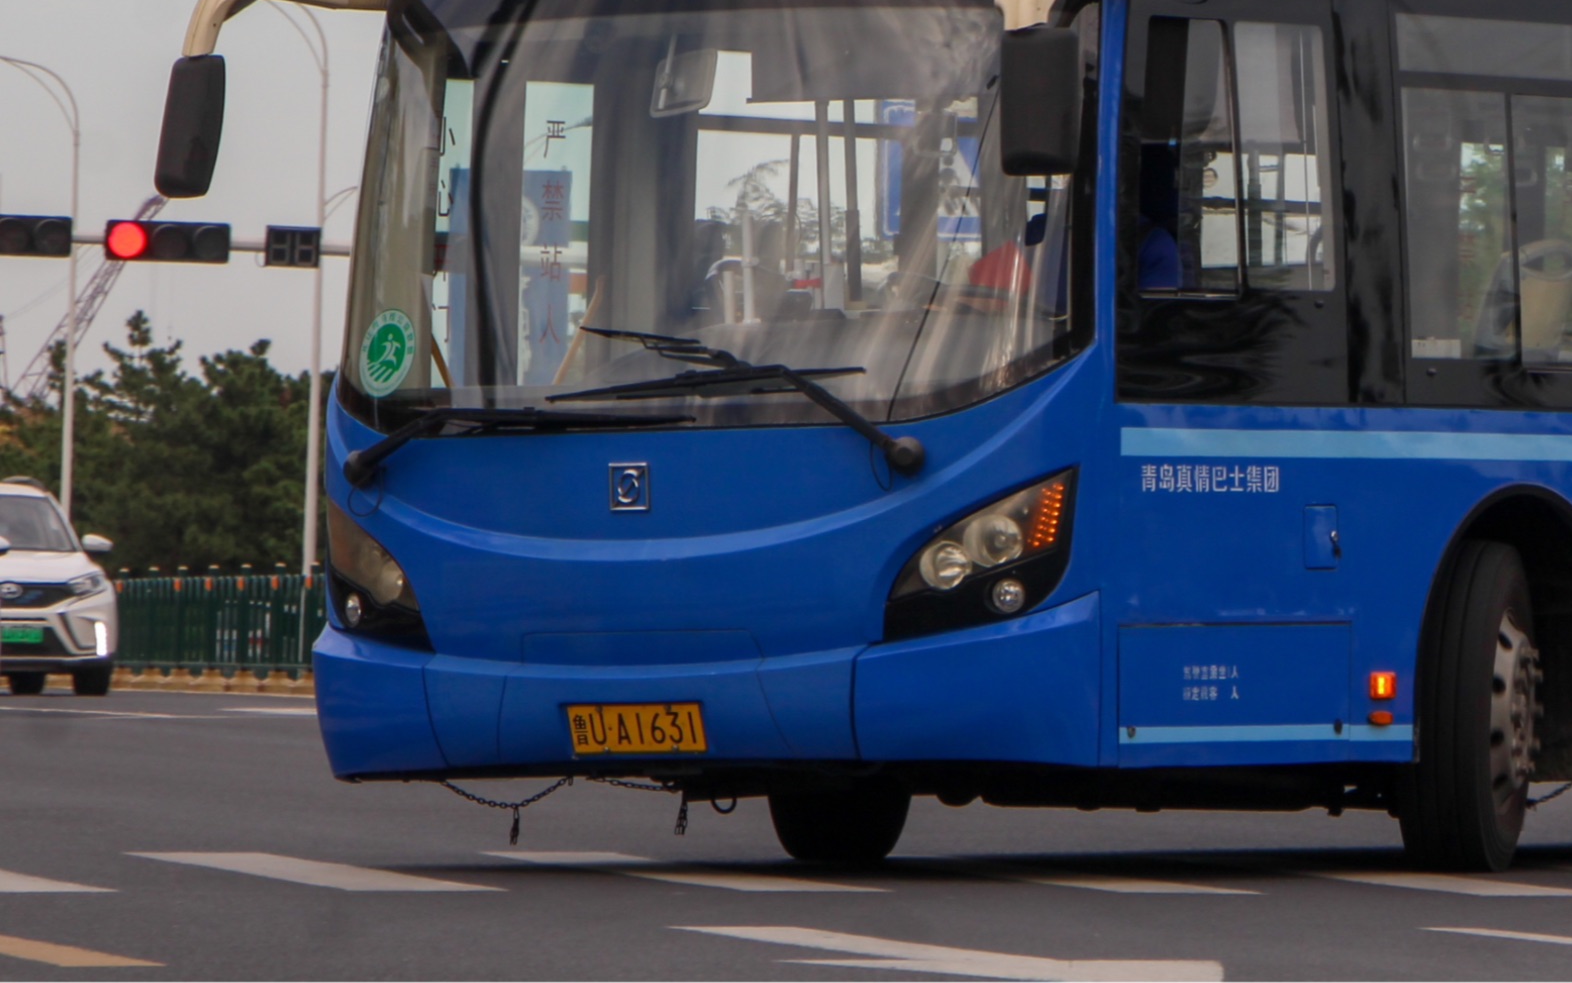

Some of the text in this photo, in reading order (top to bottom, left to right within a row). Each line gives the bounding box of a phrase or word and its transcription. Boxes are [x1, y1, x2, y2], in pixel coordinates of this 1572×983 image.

[539, 120, 567, 345] 严禁站人
[1141, 464, 1279, 493] 青岛真情巴士集团
